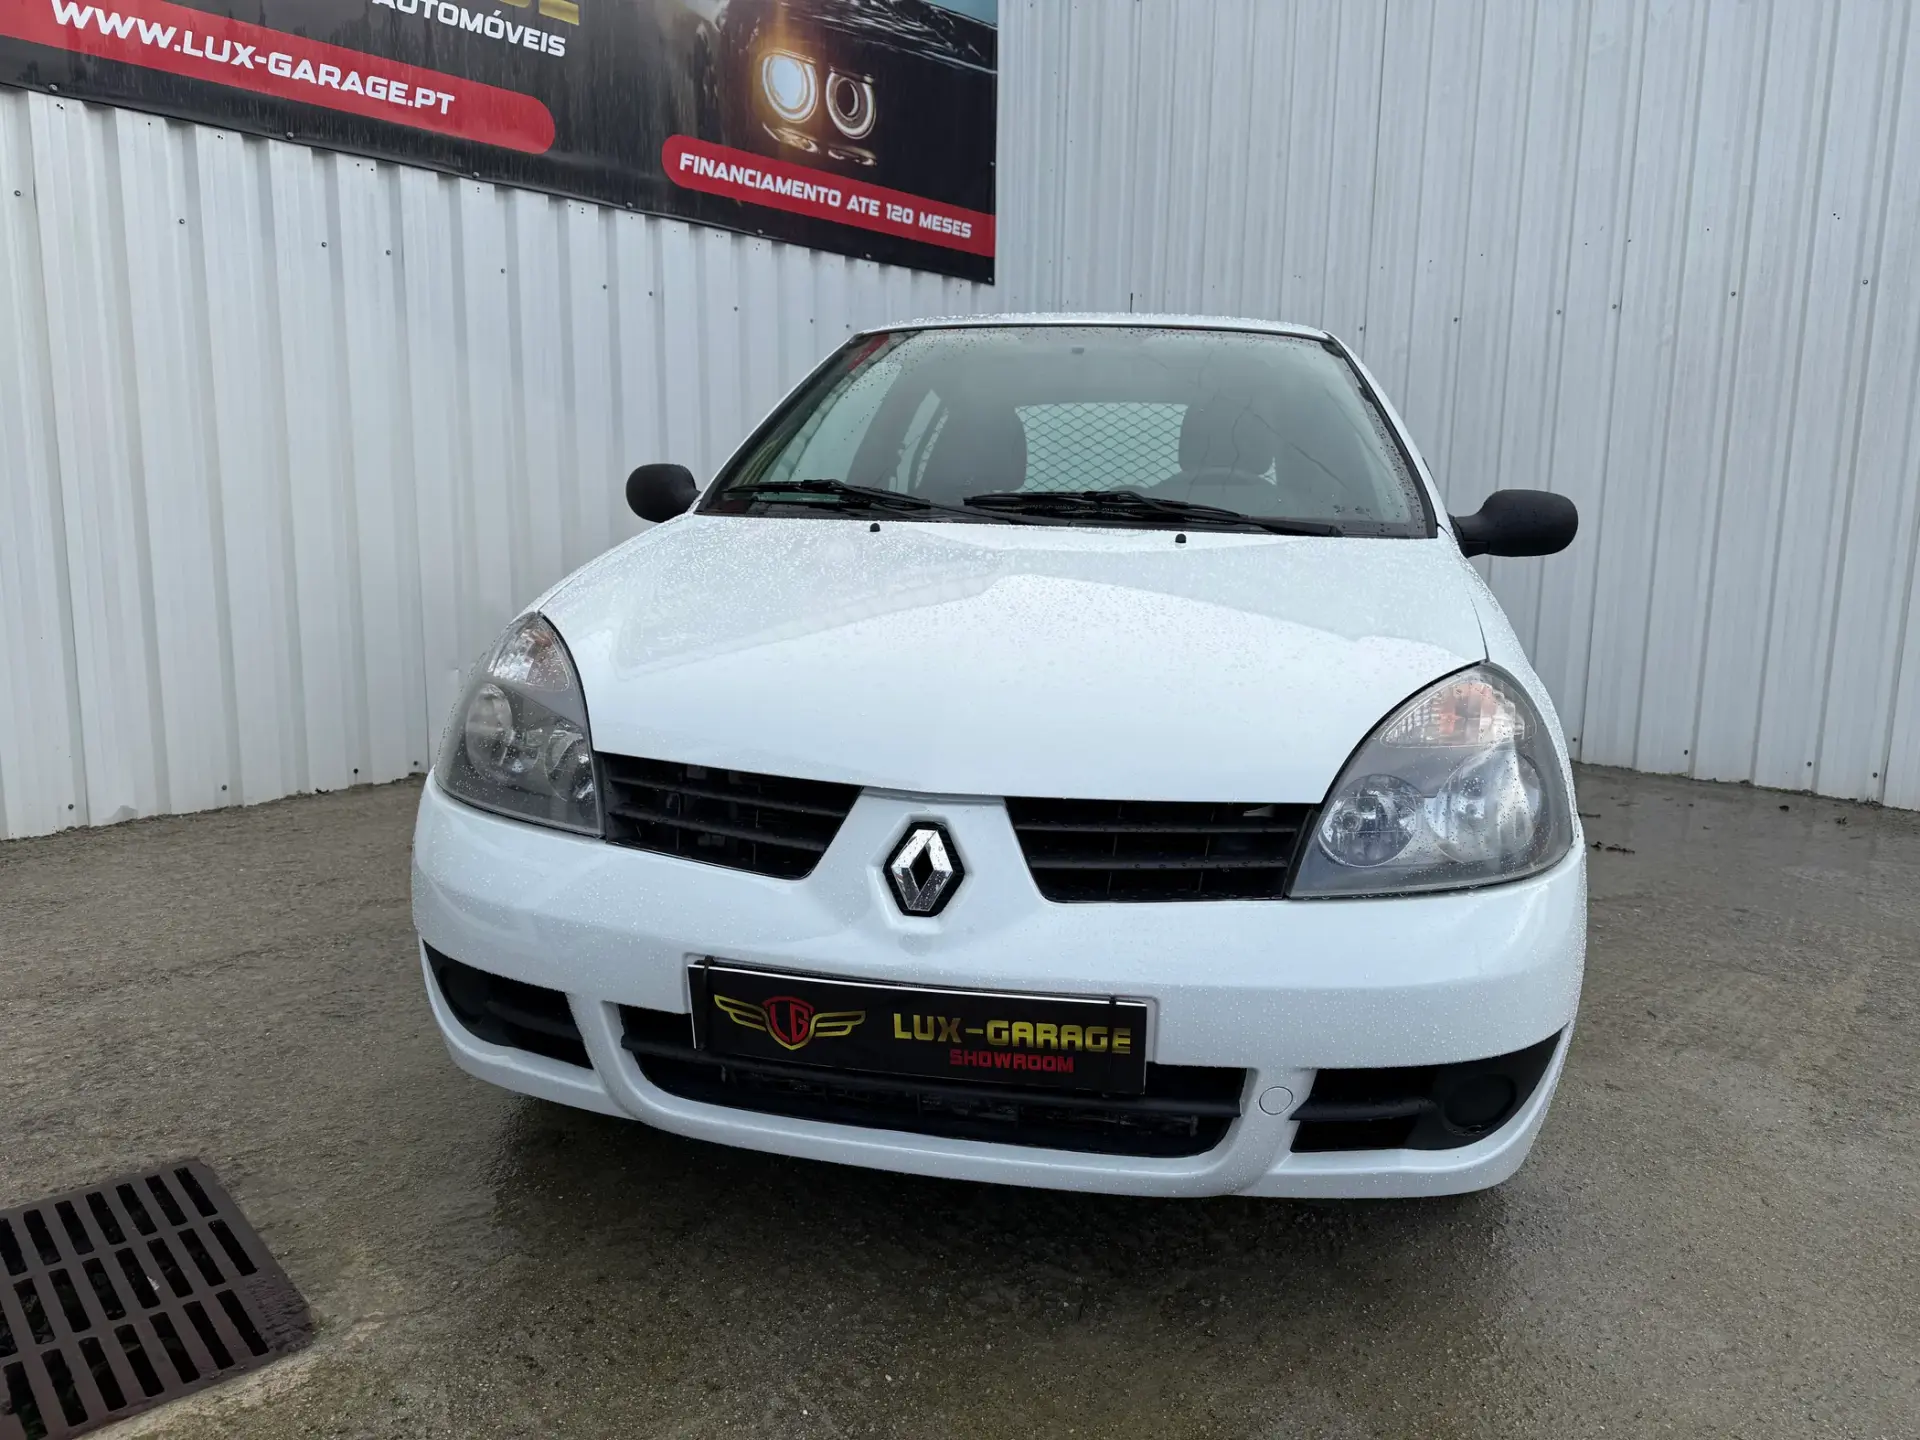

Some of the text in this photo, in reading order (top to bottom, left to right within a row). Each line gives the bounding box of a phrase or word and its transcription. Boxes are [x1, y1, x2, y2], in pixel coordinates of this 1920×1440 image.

[51, 0, 455, 115] WWW.LUX-GARAGE.PT
[679, 152, 972, 239] FINANCIAMENTO ATE 120 MESES
[893, 1013, 1131, 1055] LUX-GARAGE
[949, 1049, 1074, 1073] SHOWROOM
